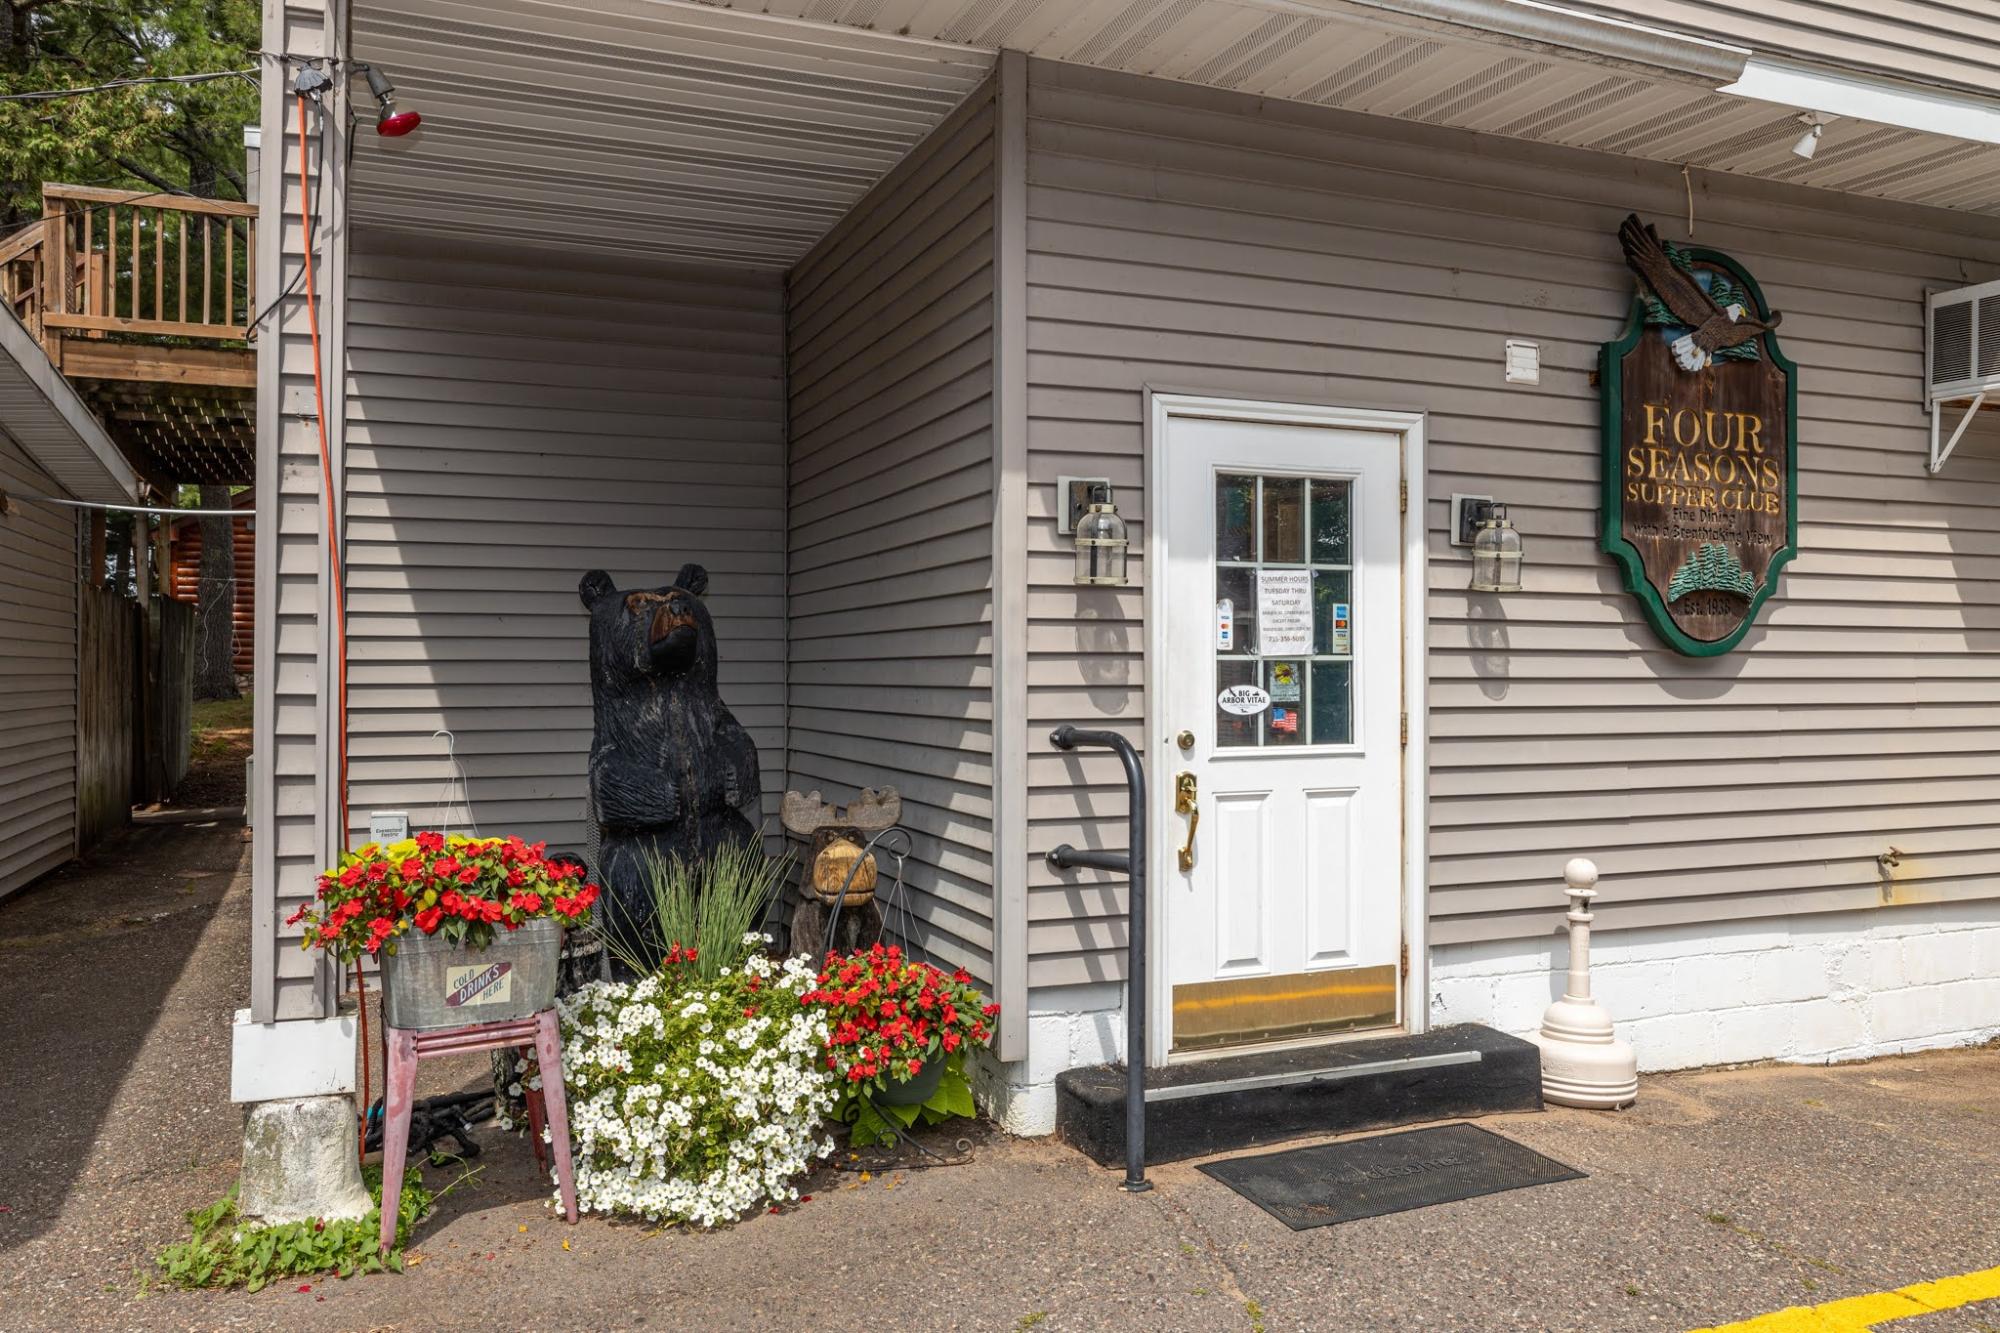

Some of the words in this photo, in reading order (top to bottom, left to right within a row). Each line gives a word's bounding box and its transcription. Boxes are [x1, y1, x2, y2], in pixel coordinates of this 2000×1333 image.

[1643, 403, 1765, 453] FOUR
[1627, 447, 1780, 490] SEASONS
[1626, 482, 1718, 509] SUPPER
[1721, 488, 1780, 515] CLUB
[1672, 507, 1696, 521] Fine
[1700, 509, 1736, 528] Dining
[1663, 526, 1670, 537] a
[1673, 524, 1742, 546] Breathtaking
[1746, 530, 1773, 545] View
[1684, 598, 1703, 615] Est.
[453, 968, 475, 990] COLD
[459, 964, 500, 1003] DRINKS
[482, 977, 505, 1001] HERE
